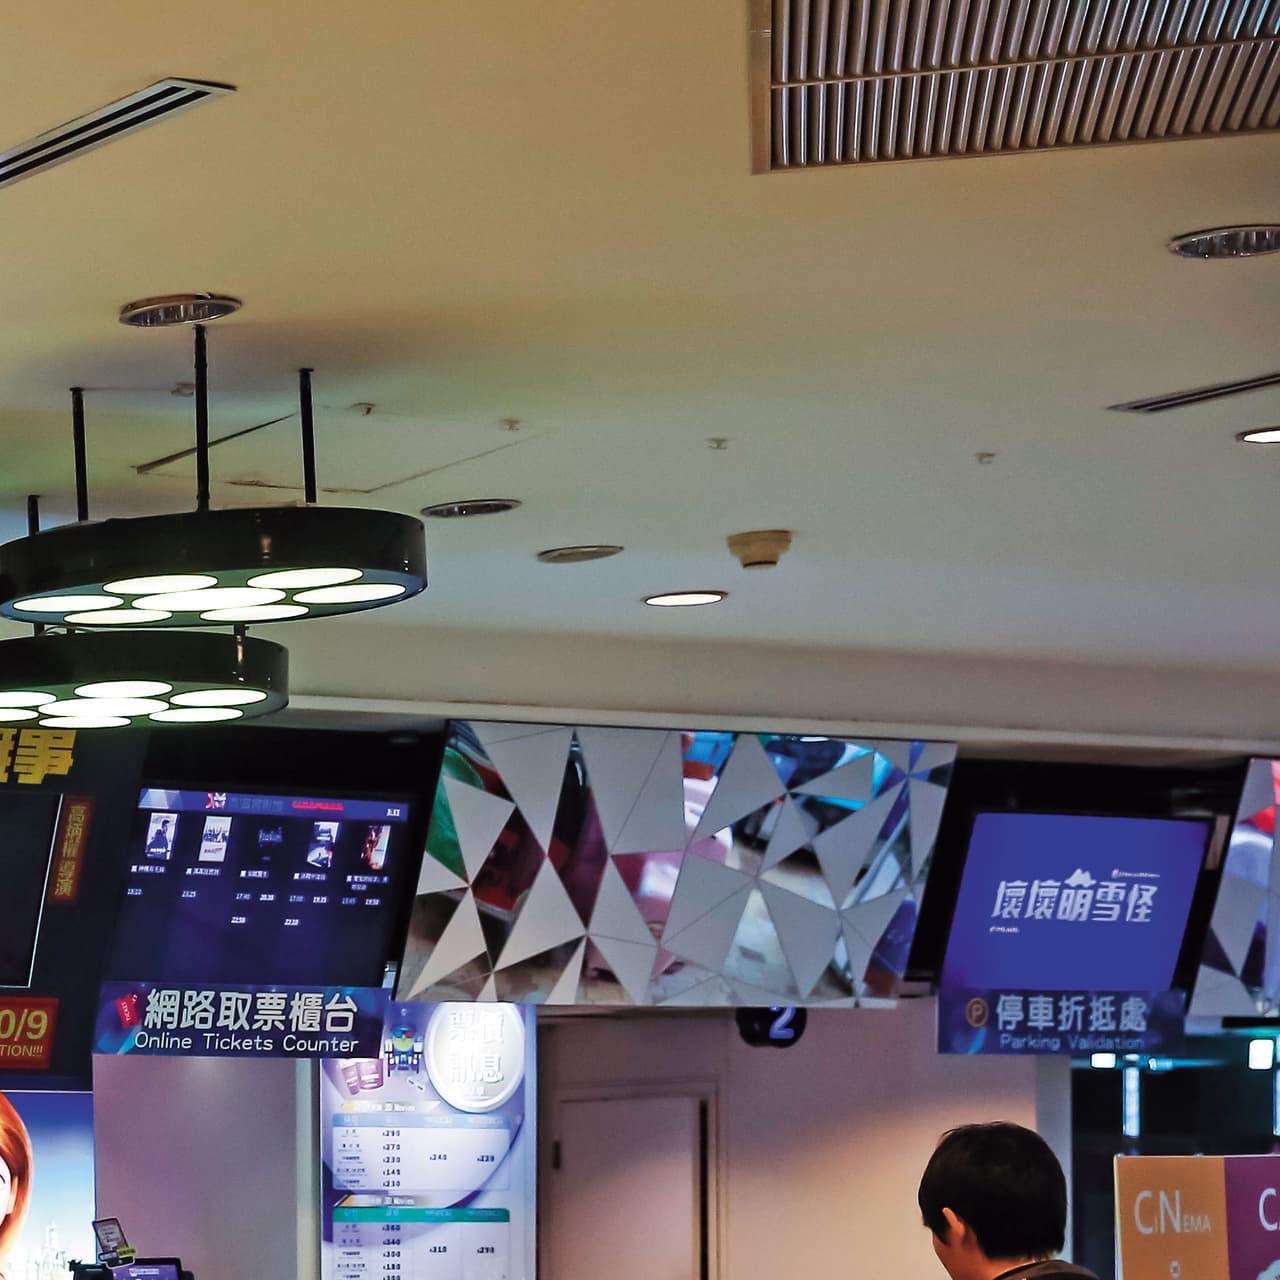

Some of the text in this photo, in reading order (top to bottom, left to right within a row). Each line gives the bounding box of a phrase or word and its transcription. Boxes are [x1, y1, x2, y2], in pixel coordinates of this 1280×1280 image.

[991, 868, 1158, 922] 壞壞萌雪怪
[144, 988, 359, 1033] 網路取票櫃台
[996, 994, 1148, 1033] 停車折抵處
[135, 1031, 359, 1052] Online Tickets Counter
[1000, 1033, 1145, 1051] Parking Validation
